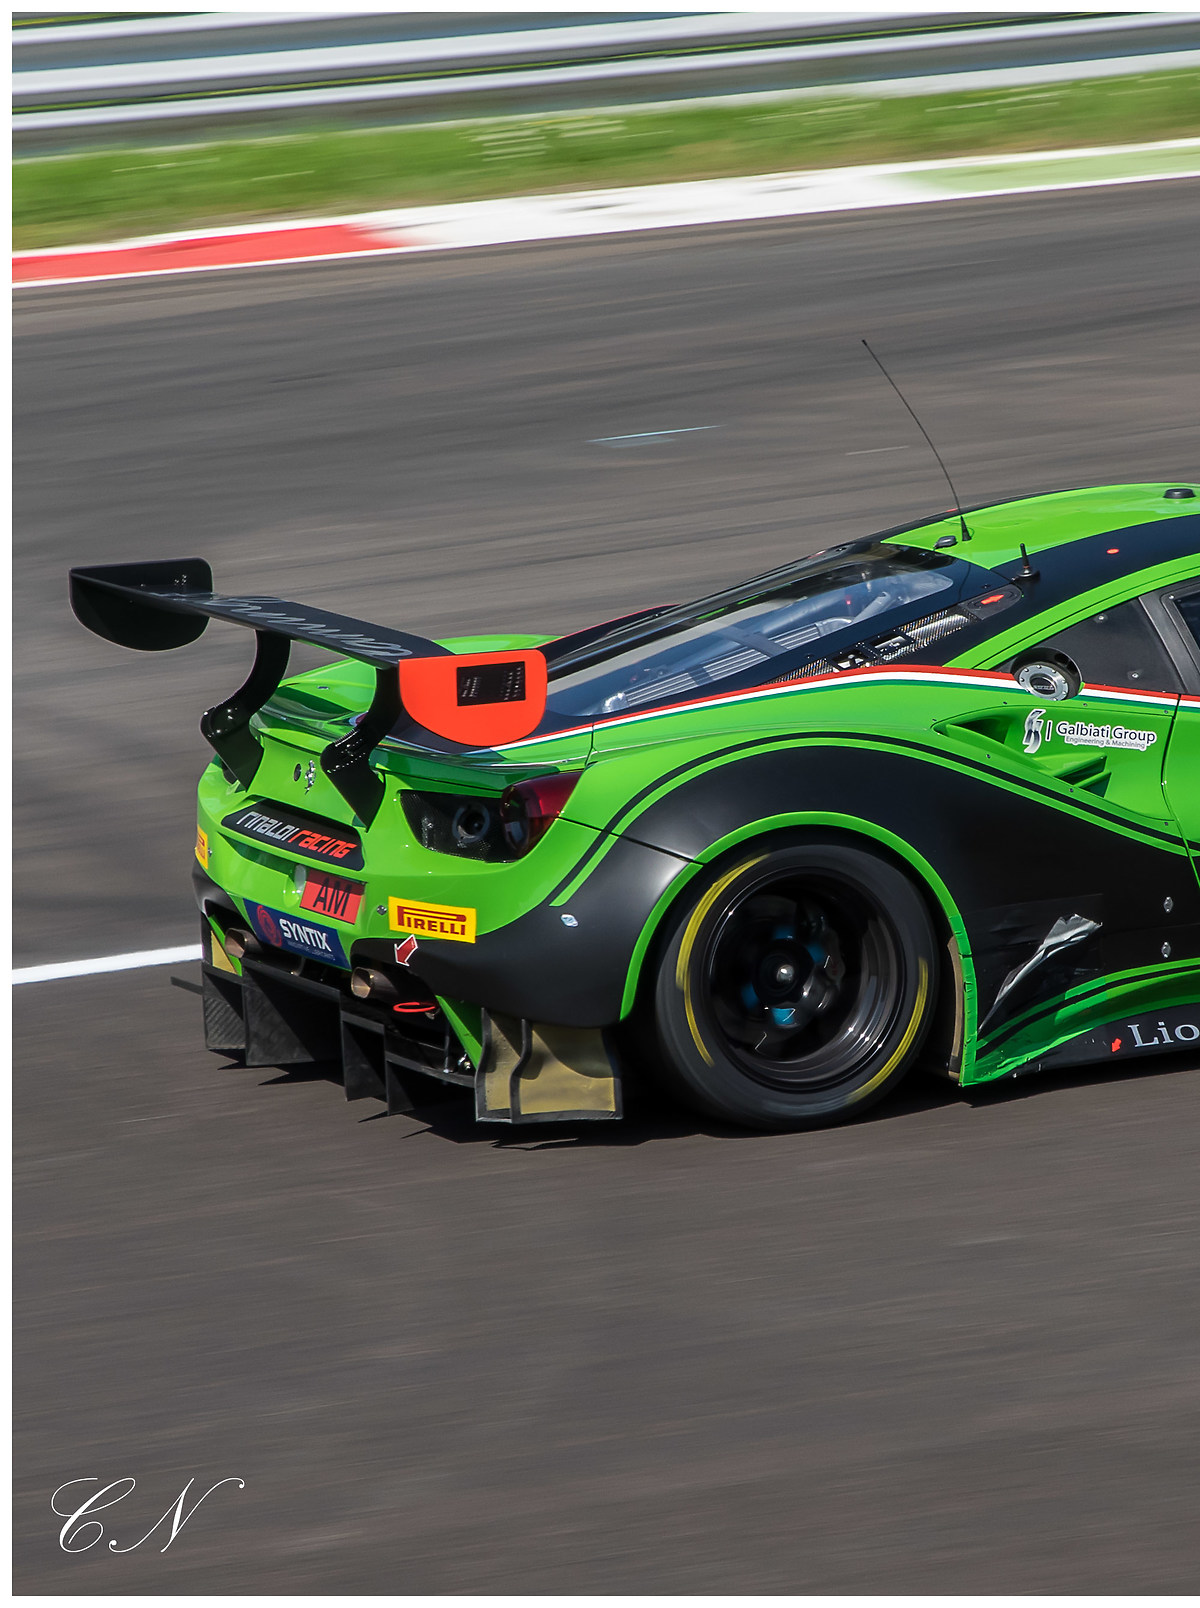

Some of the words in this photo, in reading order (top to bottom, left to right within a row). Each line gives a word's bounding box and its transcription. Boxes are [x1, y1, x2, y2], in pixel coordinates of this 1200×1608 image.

[1057, 721, 1110, 738] Galbiati
[1113, 727, 1156, 744] Group
[1065, 735, 1105, 746] Engineering
[1111, 740, 1146, 749] Machining
[313, 877, 353, 917] AM
[279, 918, 332, 952] SYNTIX
[397, 905, 467, 936] PIRELLI
